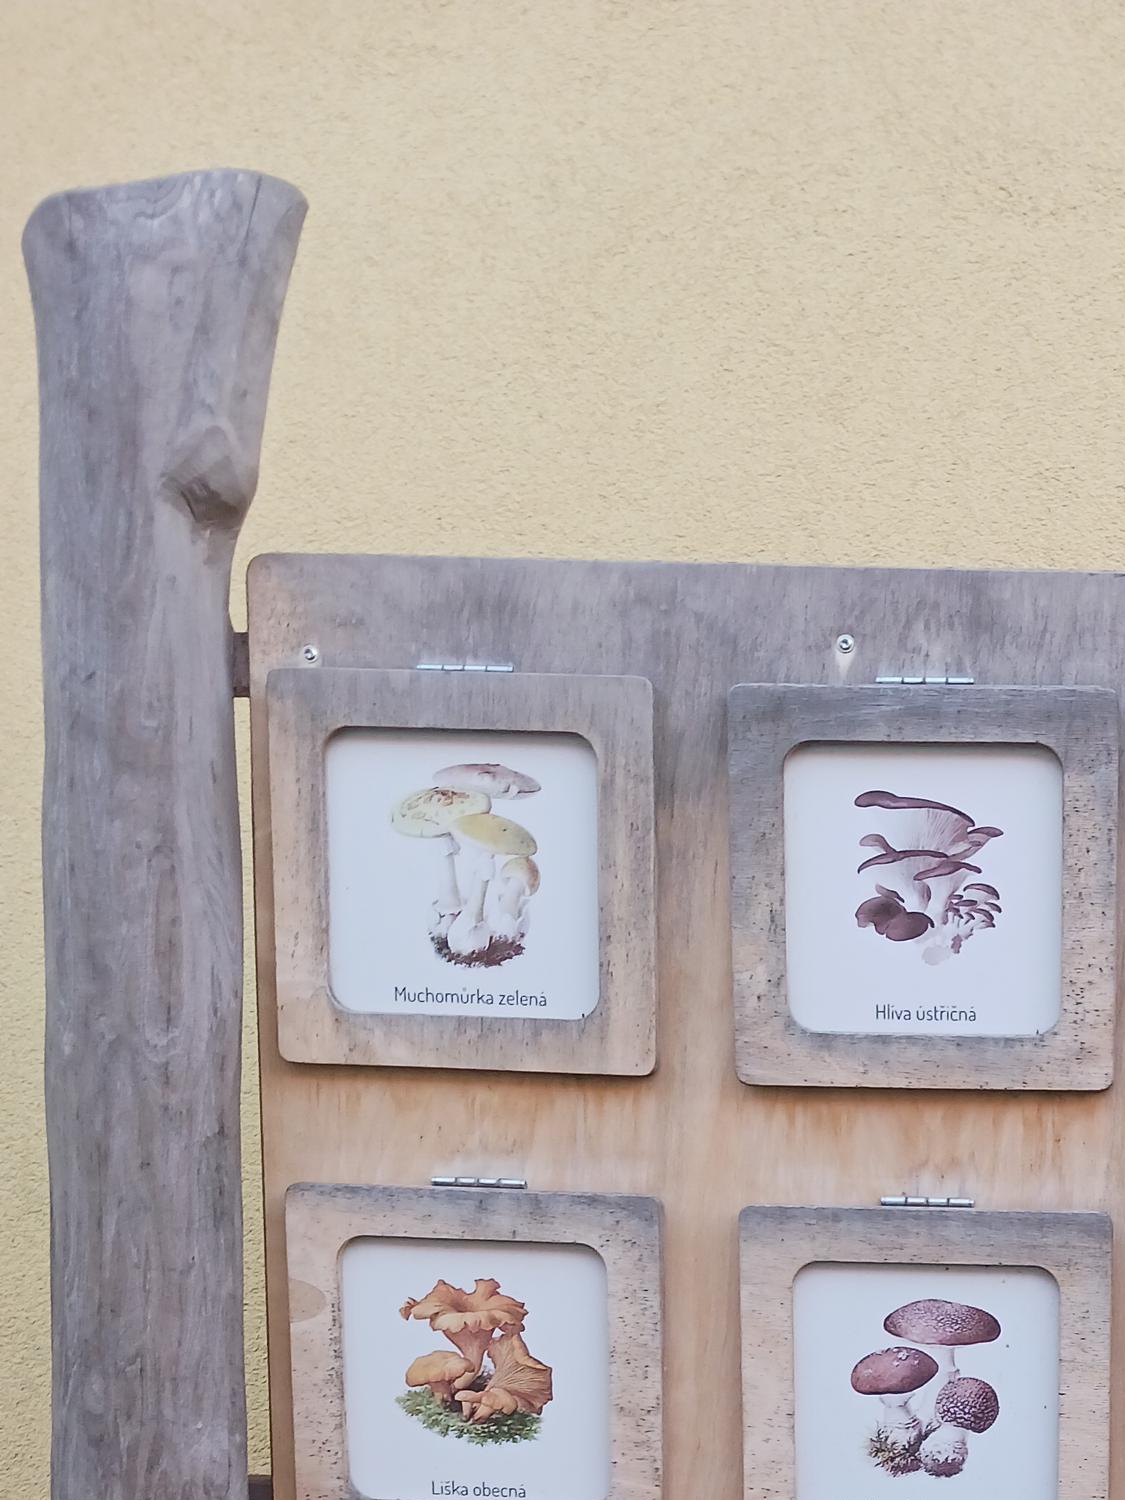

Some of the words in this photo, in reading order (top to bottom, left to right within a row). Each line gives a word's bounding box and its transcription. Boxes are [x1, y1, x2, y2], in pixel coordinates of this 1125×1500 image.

[394, 986, 494, 1006] Muchomůrka
[498, 989, 548, 1007] zelená
[875, 1003, 912, 1021] Hlíva
[915, 1005, 977, 1022] ústřičná
[431, 1480, 469, 1497] Liška
[472, 1481, 527, 1499] obecná
